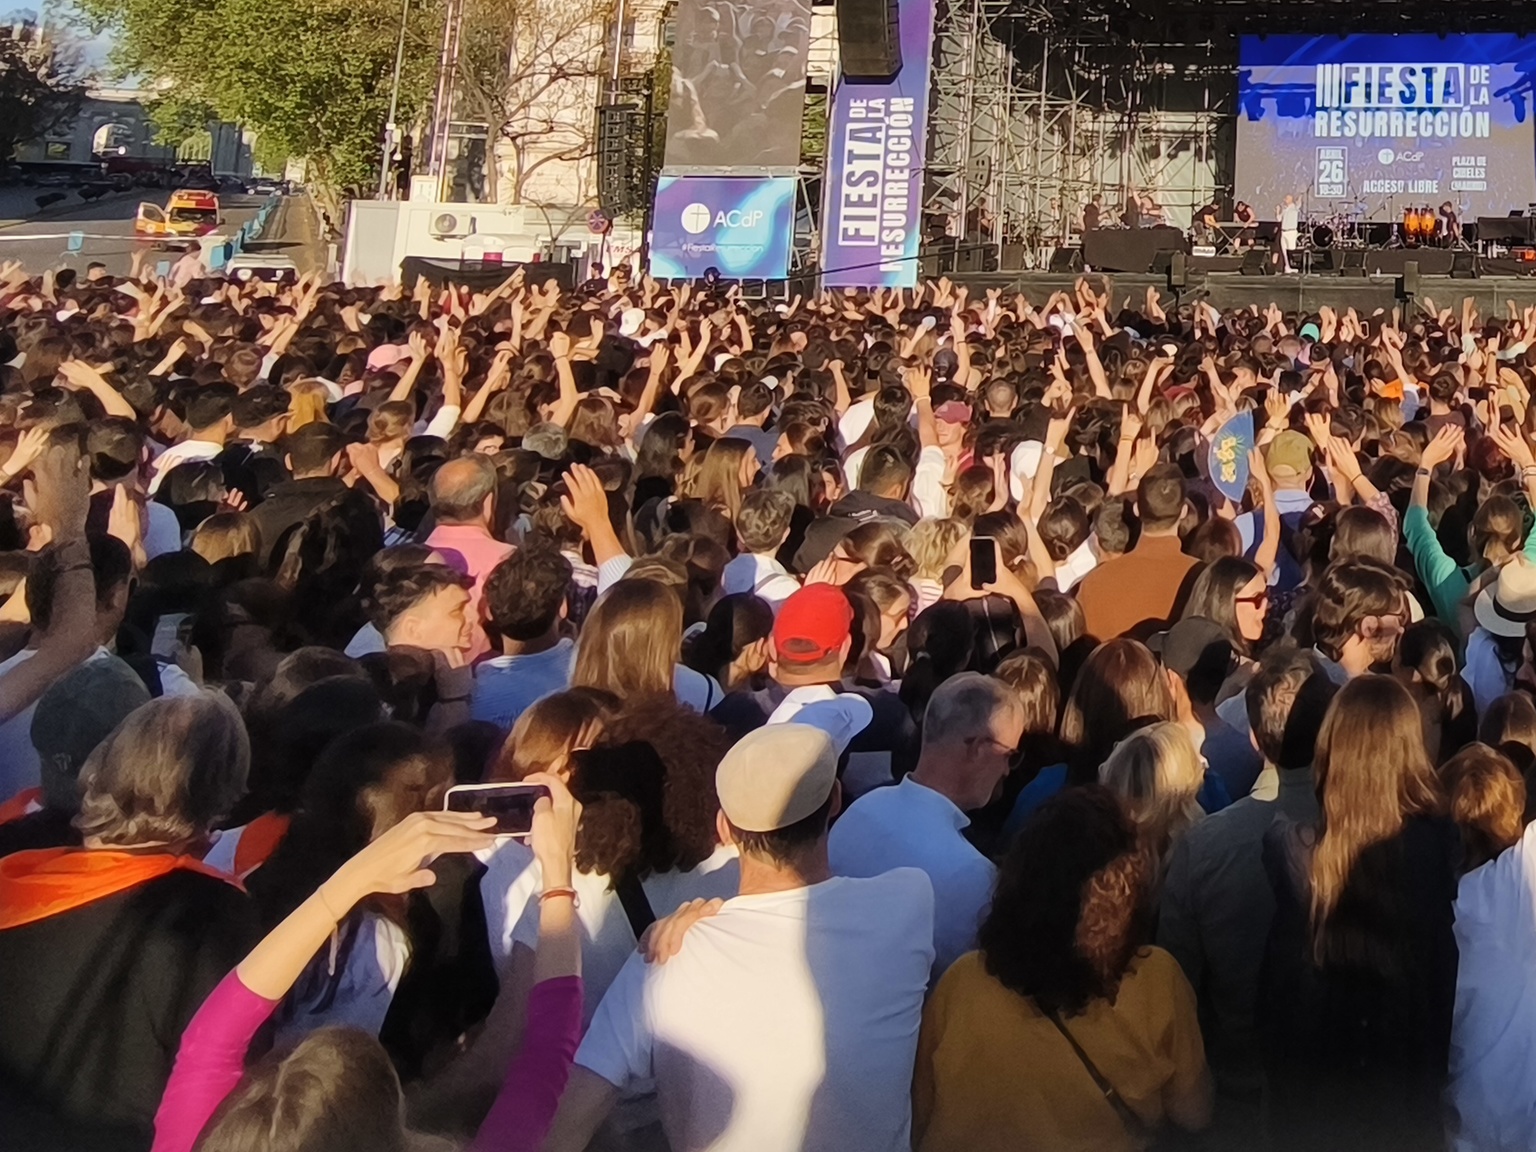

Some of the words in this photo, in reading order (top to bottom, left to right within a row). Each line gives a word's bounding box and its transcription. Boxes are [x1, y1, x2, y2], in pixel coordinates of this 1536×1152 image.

[1469, 65, 1490, 84] DE
[1344, 66, 1462, 104] FIESTA
[1469, 87, 1490, 105] LA
[849, 98, 867, 118] DE
[868, 98, 886, 118] LA
[1315, 106, 1490, 138] RESURRECCIÓN
[1452, 156, 1475, 166] PLAZA
[1319, 160, 1344, 183] 26
[842, 126, 883, 243] FIESTA
[879, 98, 914, 272] RESURRECCIÓN
[1363, 179, 1404, 193] ACCESO
[1408, 179, 1439, 194] LIBRE
[713, 209, 763, 228] ACdP
